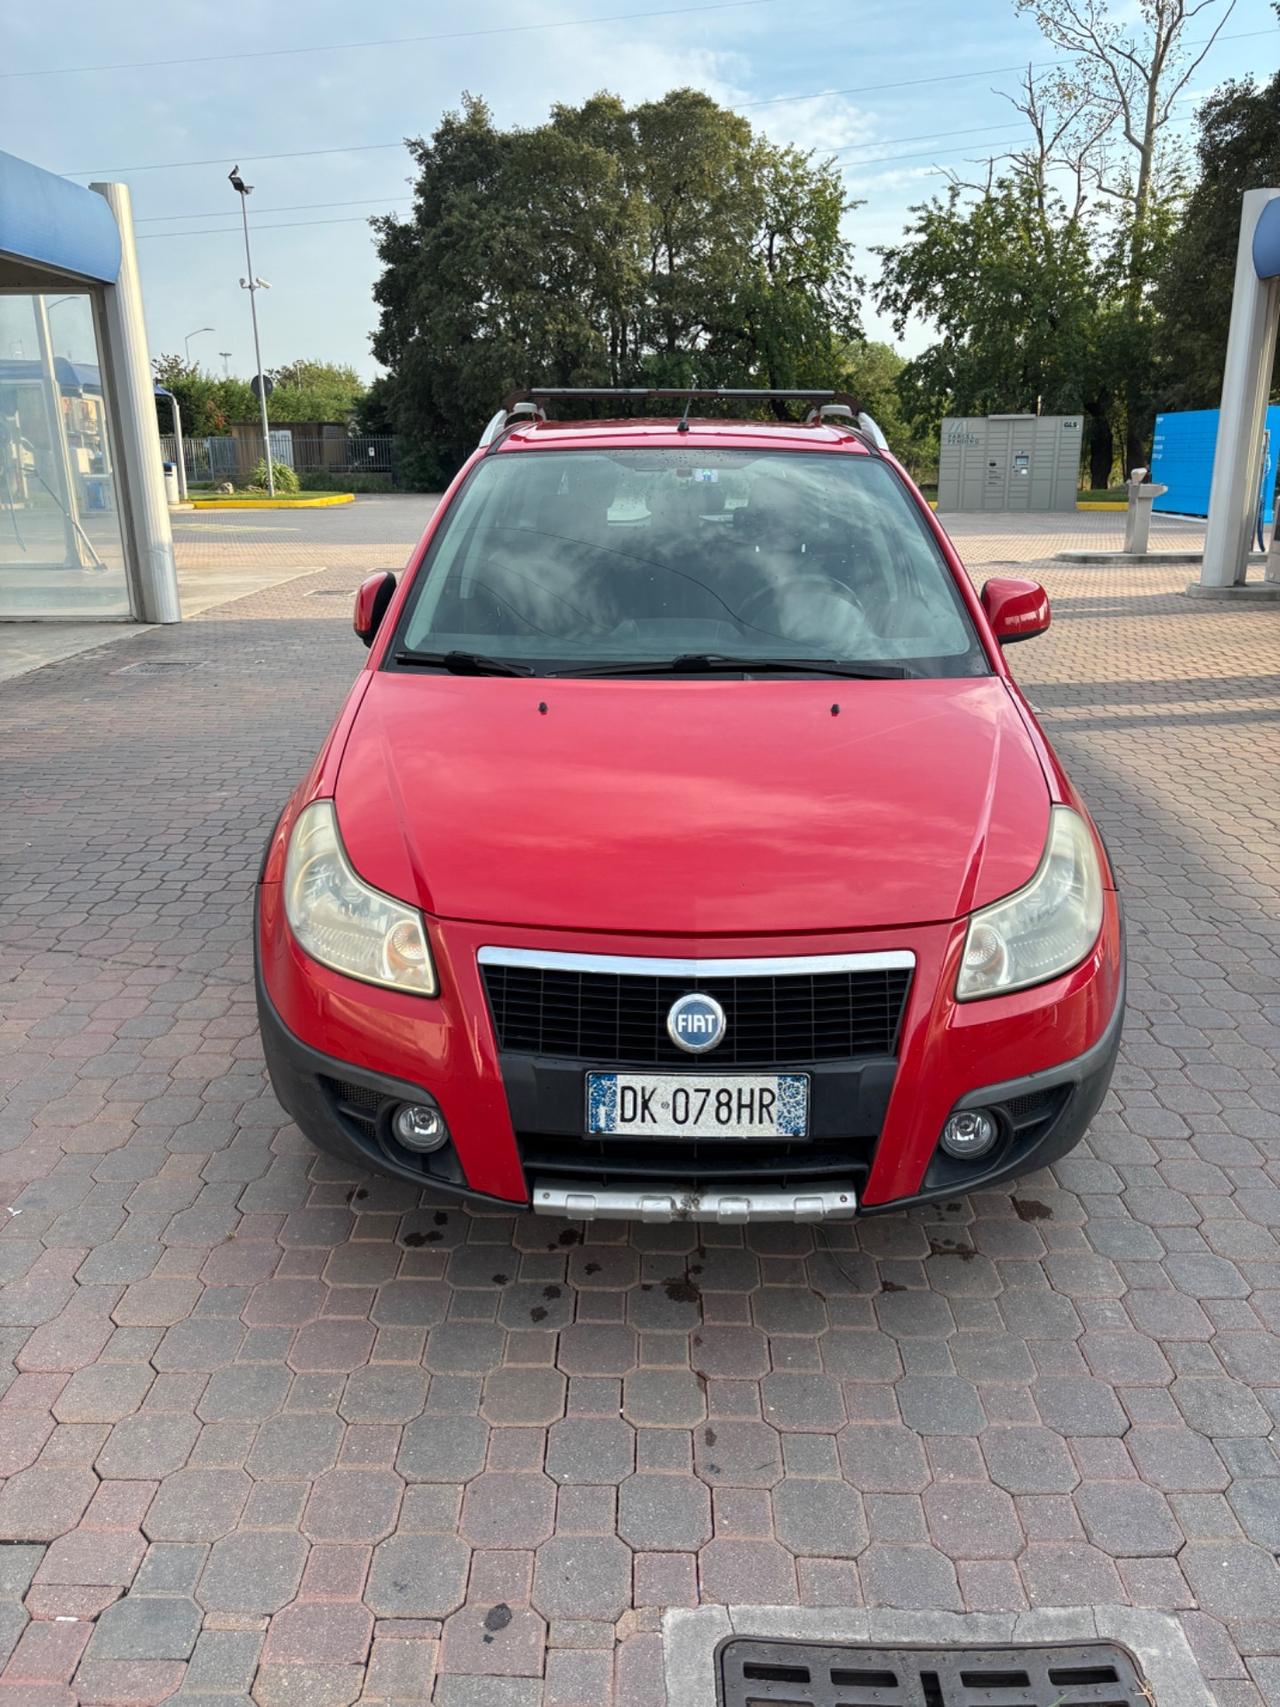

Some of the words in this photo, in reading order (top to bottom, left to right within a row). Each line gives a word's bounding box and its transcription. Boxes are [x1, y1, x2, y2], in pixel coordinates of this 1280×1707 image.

[677, 1013, 716, 1033] FIAT
[619, 1085, 658, 1124] DK
[671, 1087, 777, 1126] 078HR
